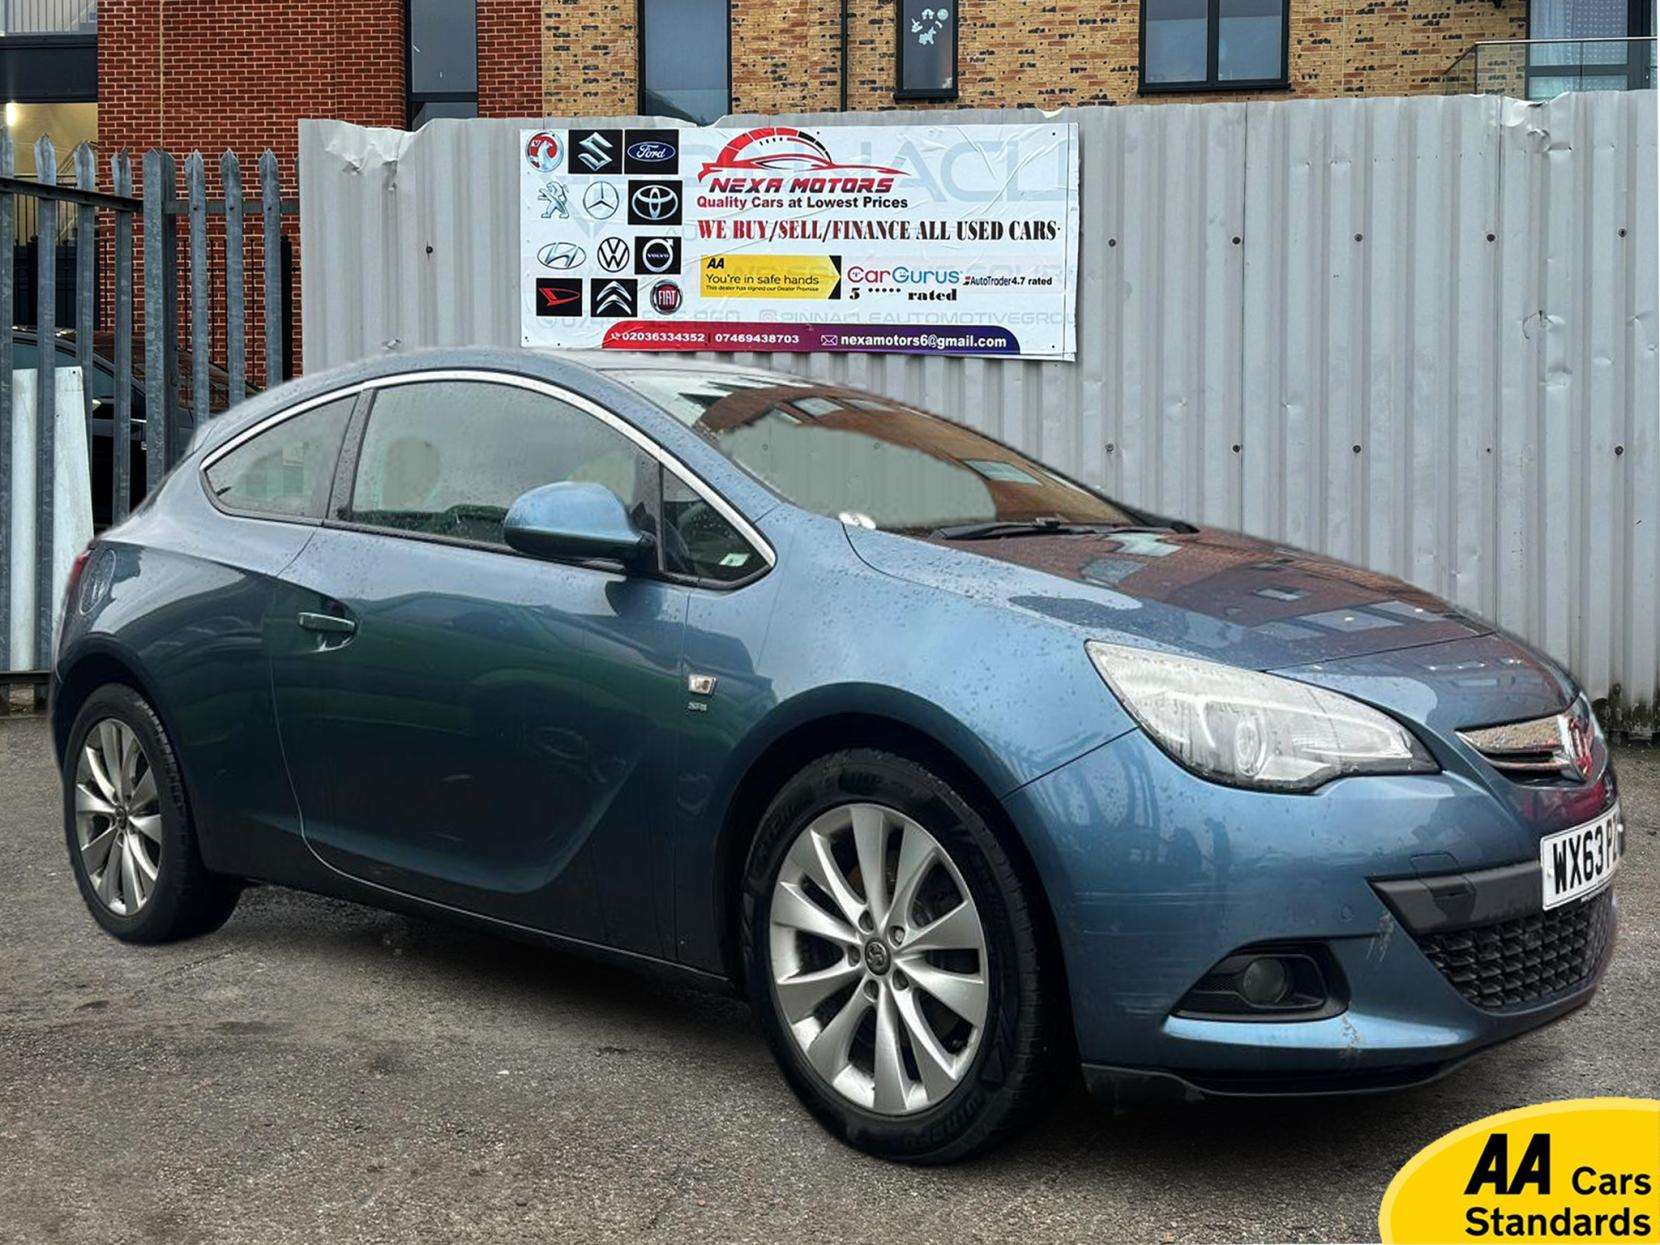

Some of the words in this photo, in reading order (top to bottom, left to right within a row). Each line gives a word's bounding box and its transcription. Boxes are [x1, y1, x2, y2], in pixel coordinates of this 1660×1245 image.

[636, 144, 666, 158] Ford
[708, 177, 784, 193] NEXA
[789, 177, 895, 193] MOTORS
[697, 196, 747, 211] Quality
[751, 196, 784, 208] Cars
[788, 197, 802, 208] at
[806, 196, 858, 208] Lowest
[862, 196, 908, 208] Prices
[697, 219, 727, 239] WE
[915, 220, 951, 240] ALL
[956, 220, 1004, 241] USED
[1008, 220, 1057, 241] CARS
[706, 257, 725, 269] AA
[706, 273, 741, 285] You're
[744, 274, 755, 284] in
[757, 274, 782, 285] safe
[784, 274, 820, 285] hands
[847, 266, 960, 284] CarGurus
[1028, 277, 1053, 286] rated
[658, 290, 677, 306] FIAT
[849, 287, 860, 300] 5
[907, 288, 958, 301] rated
[622, 332, 705, 342] 02036334352
[715, 334, 800, 344] 07469438703
[840, 335, 1007, 349] nexamotors6@gmail.com
